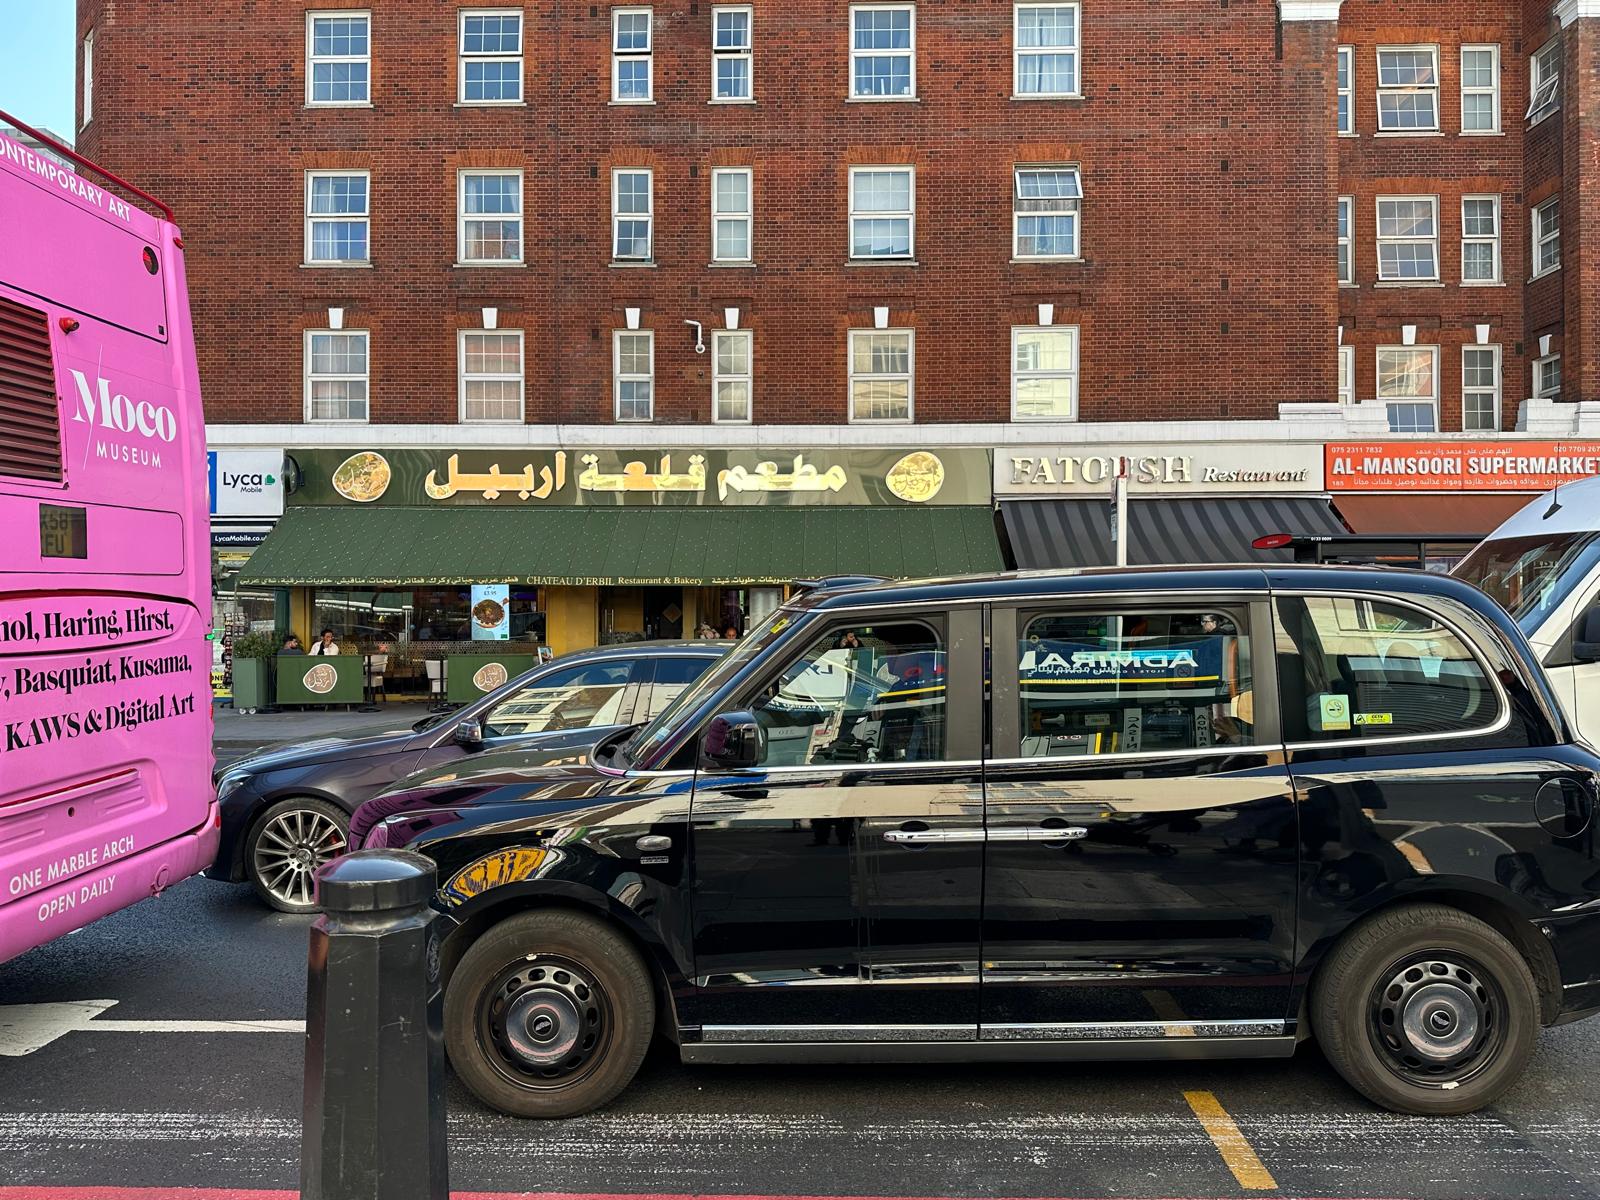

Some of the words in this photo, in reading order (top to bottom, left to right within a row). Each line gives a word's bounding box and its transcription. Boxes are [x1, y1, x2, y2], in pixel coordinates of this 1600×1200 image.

[109, 198, 130, 222] ART
[67, 368, 177, 442] Moco
[97, 440, 161, 468] MUSEUM
[1332, 457, 1462, 475] AL-MANSOORI
[1468, 456, 1600, 474] SUPERMARKE
[223, 472, 262, 488] Lyca
[579, 453, 706, 492] قلعة
[717, 453, 848, 502] مطعم
[1201, 466, 1308, 482] Restaurant
[526, 577, 573, 585] CHATEAU
[575, 577, 615, 586] D'ERBIL
[618, 577, 661, 585] Restaurant
[663, 577, 671, 585] &
[673, 577, 704, 586] Bakery
[43, 608, 123, 640] Haring,
[125, 606, 174, 632] Hirst,
[14, 658, 116, 695] Basquiat,
[119, 654, 192, 681] Kusama,
[6, 711, 81, 752] KAWS
[84, 709, 103, 735] &
[105, 693, 164, 731] Digital
[168, 691, 195, 718] Art
[9, 868, 42, 895] ONE
[47, 847, 98, 882] MARBLE
[102, 834, 135, 861] ARCH
[38, 891, 76, 922] OPEN
[80, 875, 116, 904] DAILY
